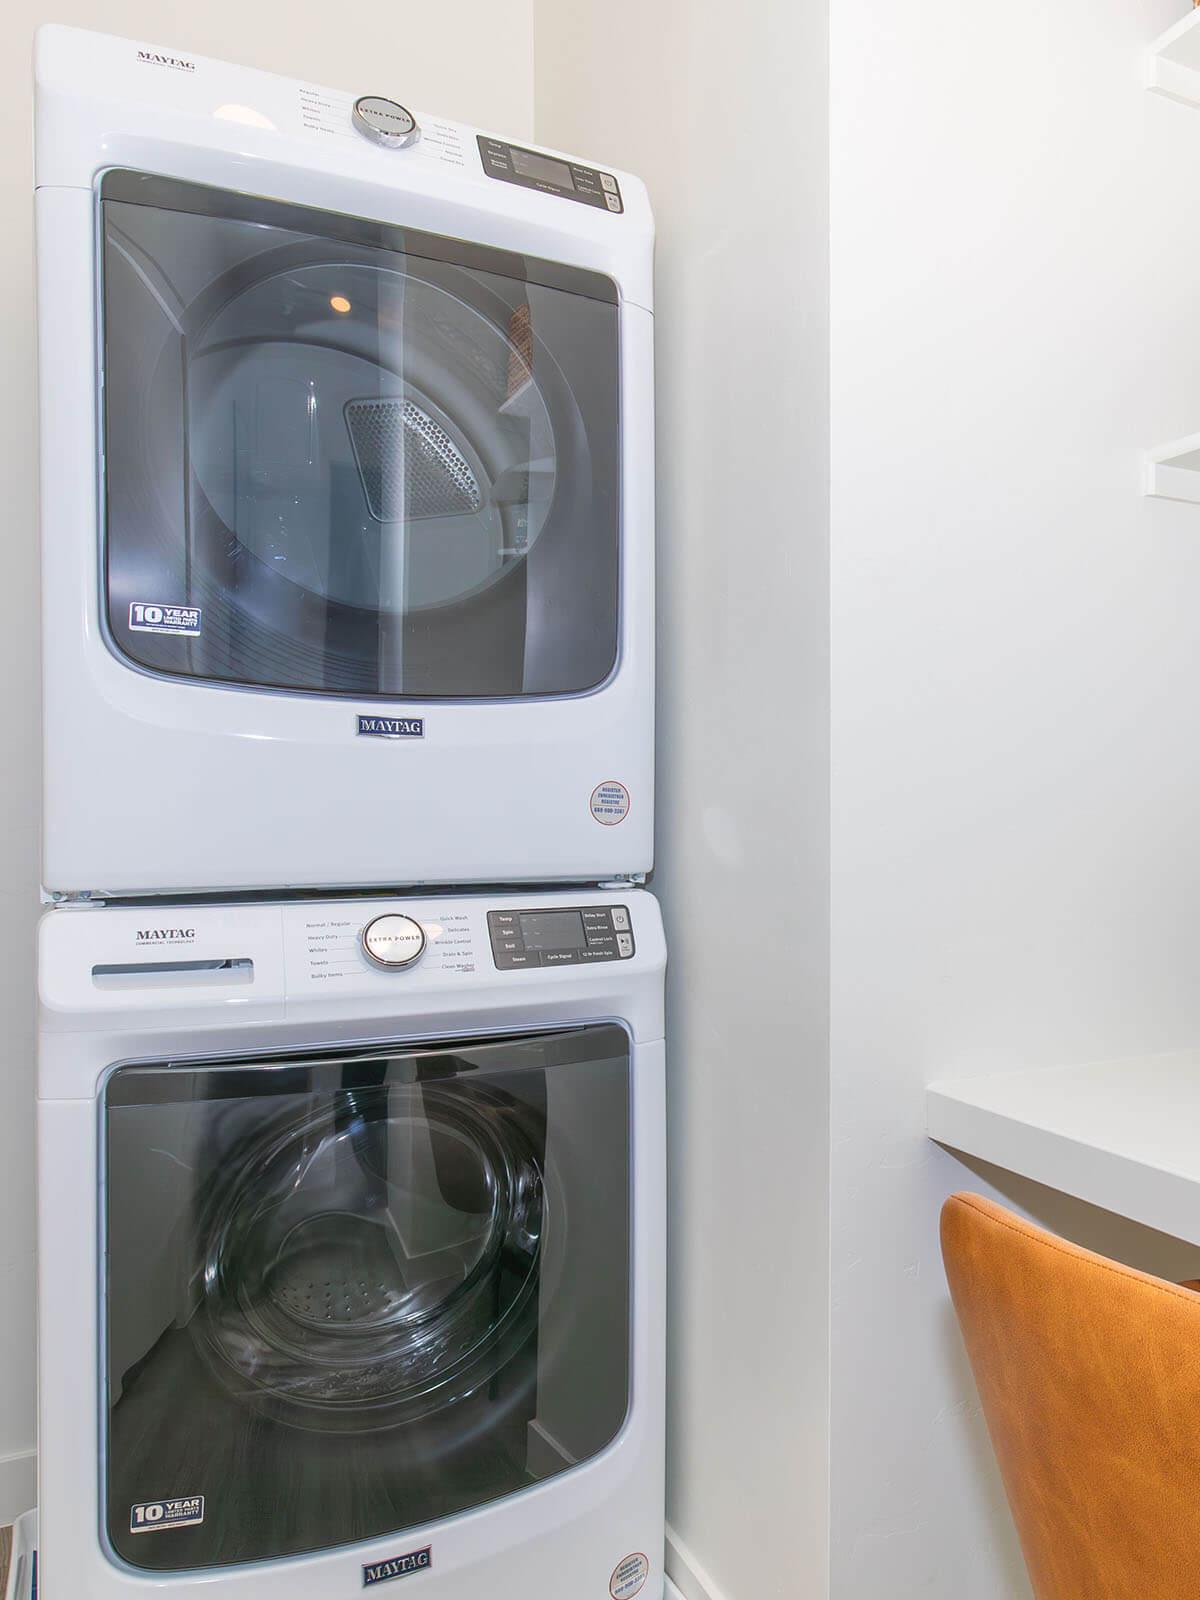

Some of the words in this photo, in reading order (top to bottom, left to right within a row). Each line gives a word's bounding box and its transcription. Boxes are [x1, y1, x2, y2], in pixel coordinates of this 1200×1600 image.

[137, 51, 195, 69] MAYTAG
[134, 605, 163, 623] 10
[164, 608, 198, 618] YEAR
[360, 719, 420, 733] MAYTAG
[136, 928, 195, 940] MAYTAG
[368, 936, 393, 944] EXTRA
[135, 1504, 164, 1523] 10
[165, 1499, 200, 1510] YEAR
[164, 1510, 200, 1519] WARRANTY
[367, 1552, 428, 1582] MAYTAG
